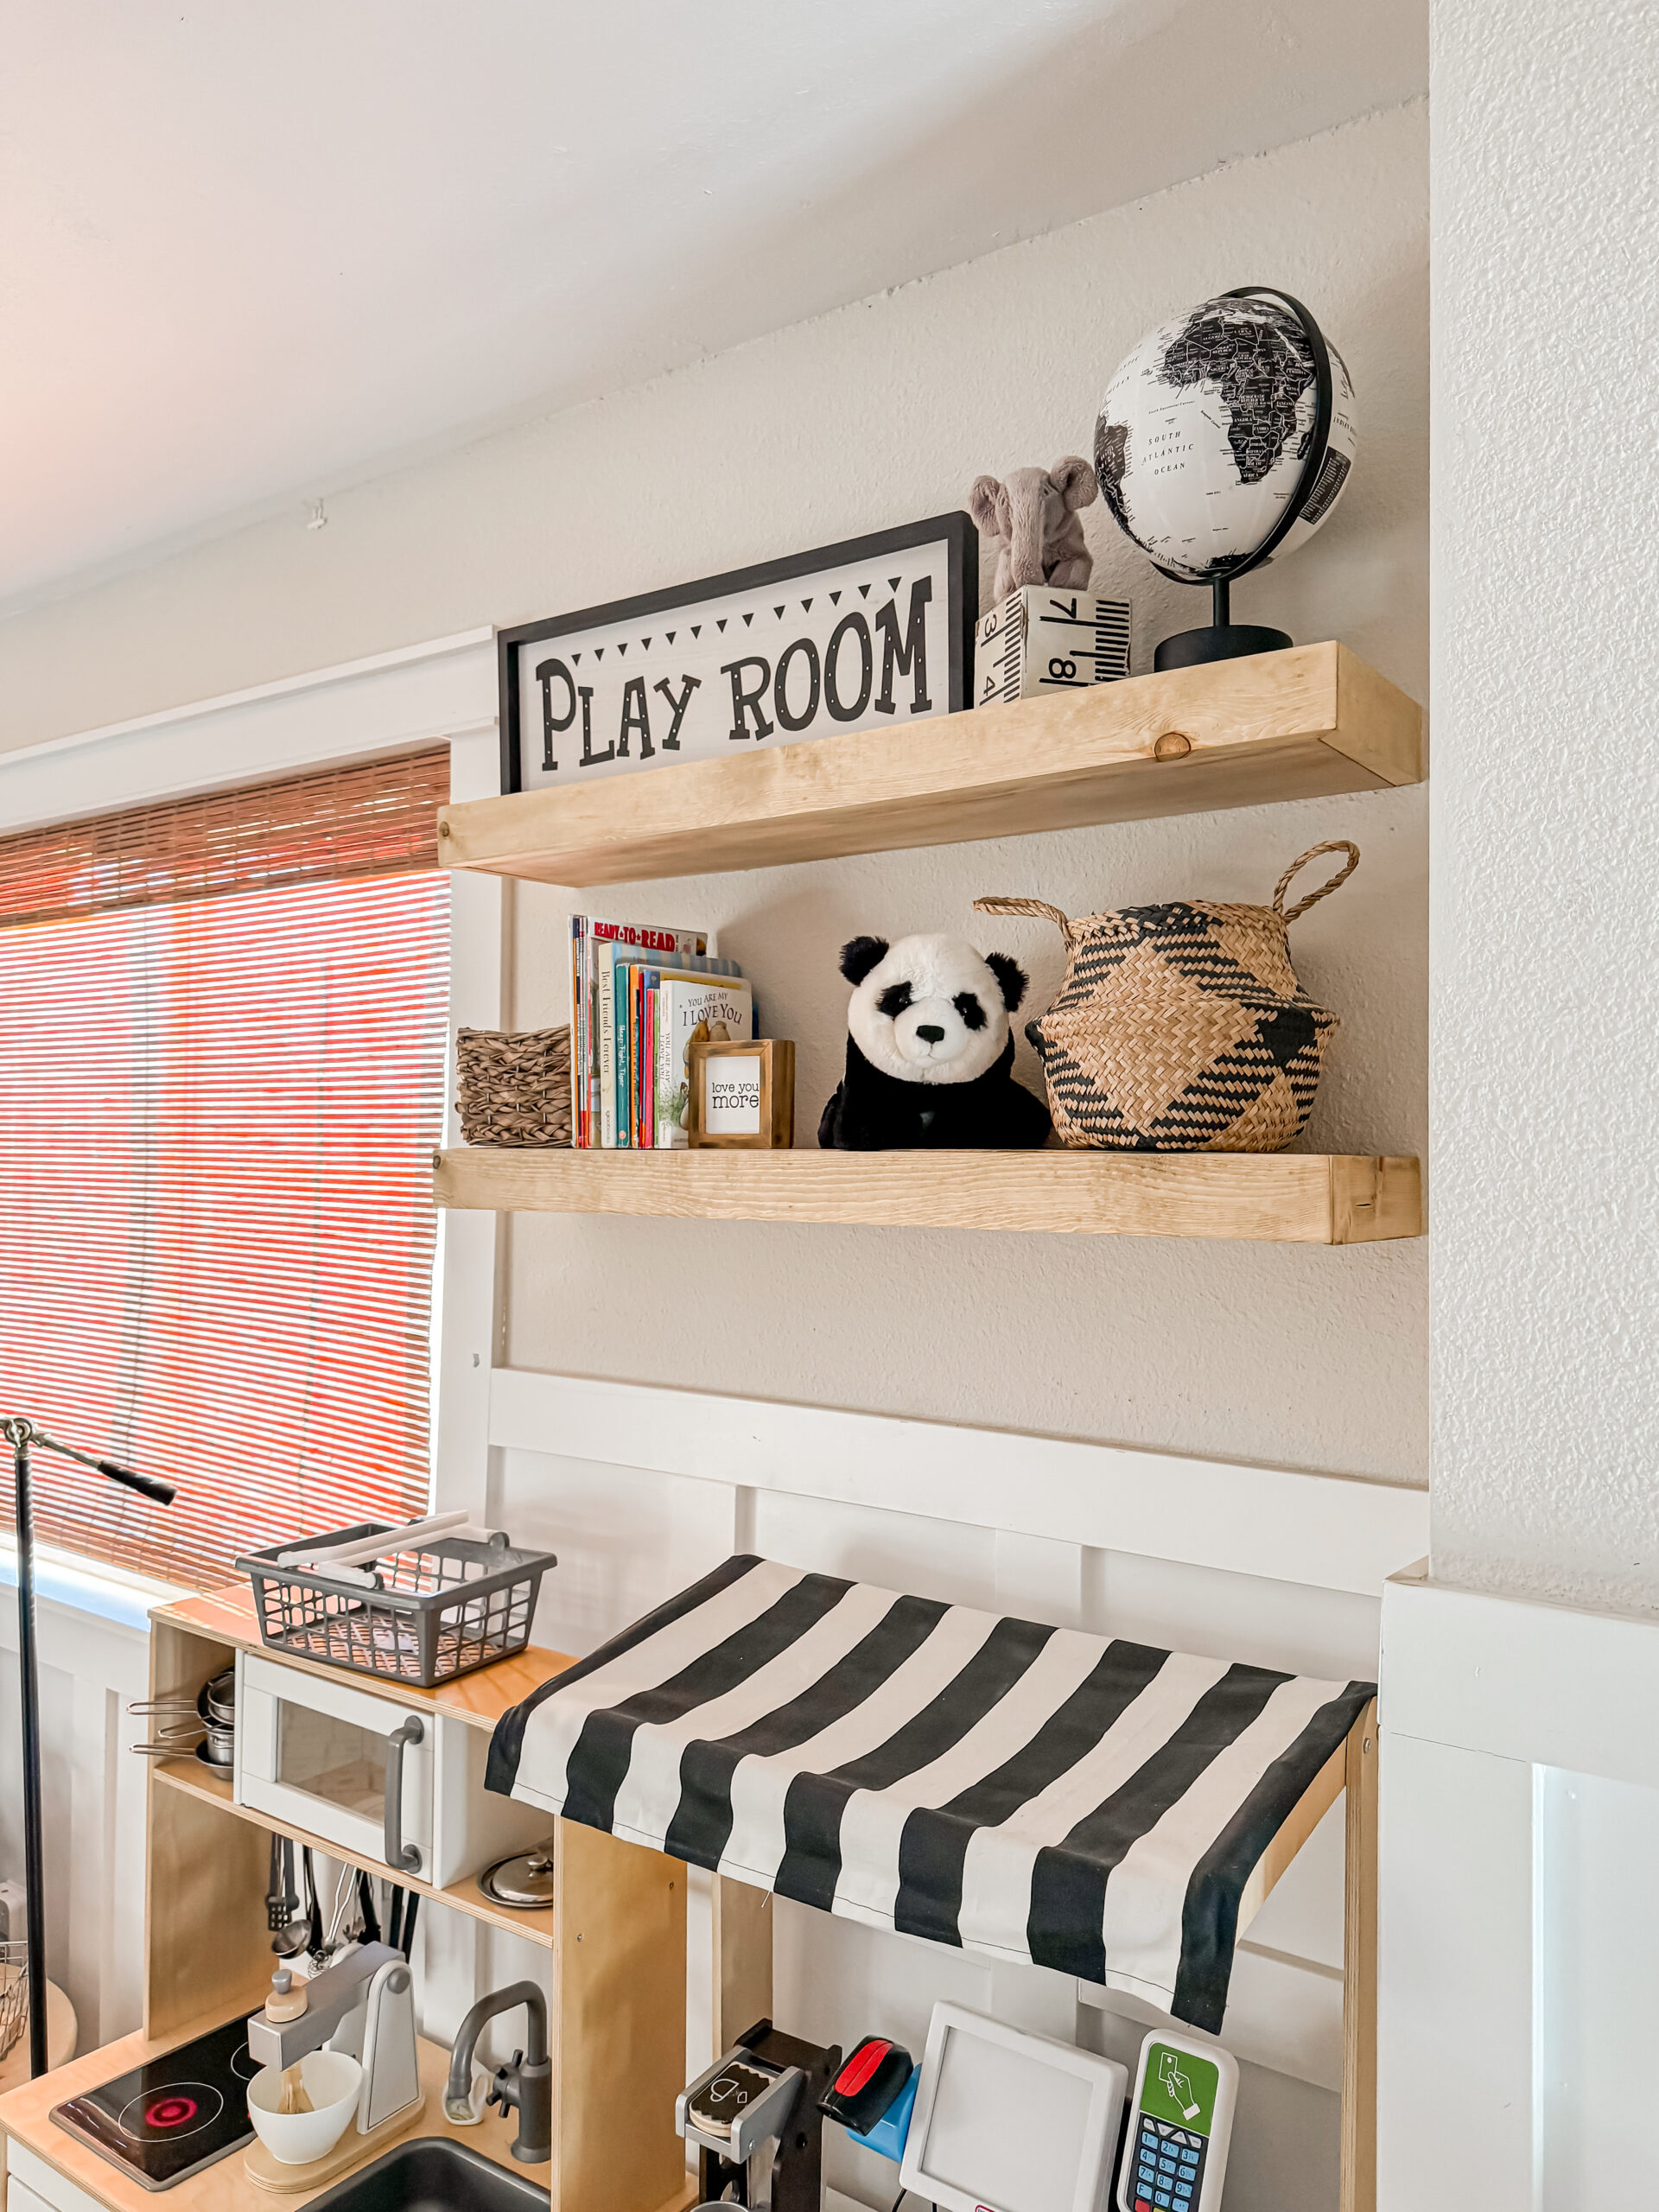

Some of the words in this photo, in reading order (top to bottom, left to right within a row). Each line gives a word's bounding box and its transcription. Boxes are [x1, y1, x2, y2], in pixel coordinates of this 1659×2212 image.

[1148, 430, 1181, 446] SOUTH
[1141, 443, 1194, 464] ATLANTIC
[1154, 462, 1185, 475] OCEAN
[1049, 597, 1077, 619] 7
[984, 613, 997, 638] 3
[536, 658, 702, 771] PLAY
[720, 575, 932, 741] ROOM
[1048, 658, 1077, 678] 8
[983, 676, 996, 697] 4
[601, 971, 611, 994] Best
[688, 996, 702, 1007] YOU
[703, 993, 716, 1003] ARE
[717, 992, 728, 1001] MY
[683, 1011, 687, 1027] I
[691, 1004, 718, 1026] LOVE
[720, 1003, 743, 1026] YOU
[712, 1082, 734, 1093] love
[738, 1083, 760, 1095] you
[712, 1095, 760, 1109] more
[1162, 2142, 1168, 2152] 2
[1183, 2151, 1188, 2159] 3
[1141, 2151, 1147, 2160] 4
[1160, 2160, 1166, 2169] 5
[1179, 2167, 1185, 2177] 6
[1138, 2184, 1144, 2193] F
[1141, 2167, 1147, 2177] 7
[1159, 2177, 1164, 2186] 8
[1177, 2183, 1183, 2192] 9
